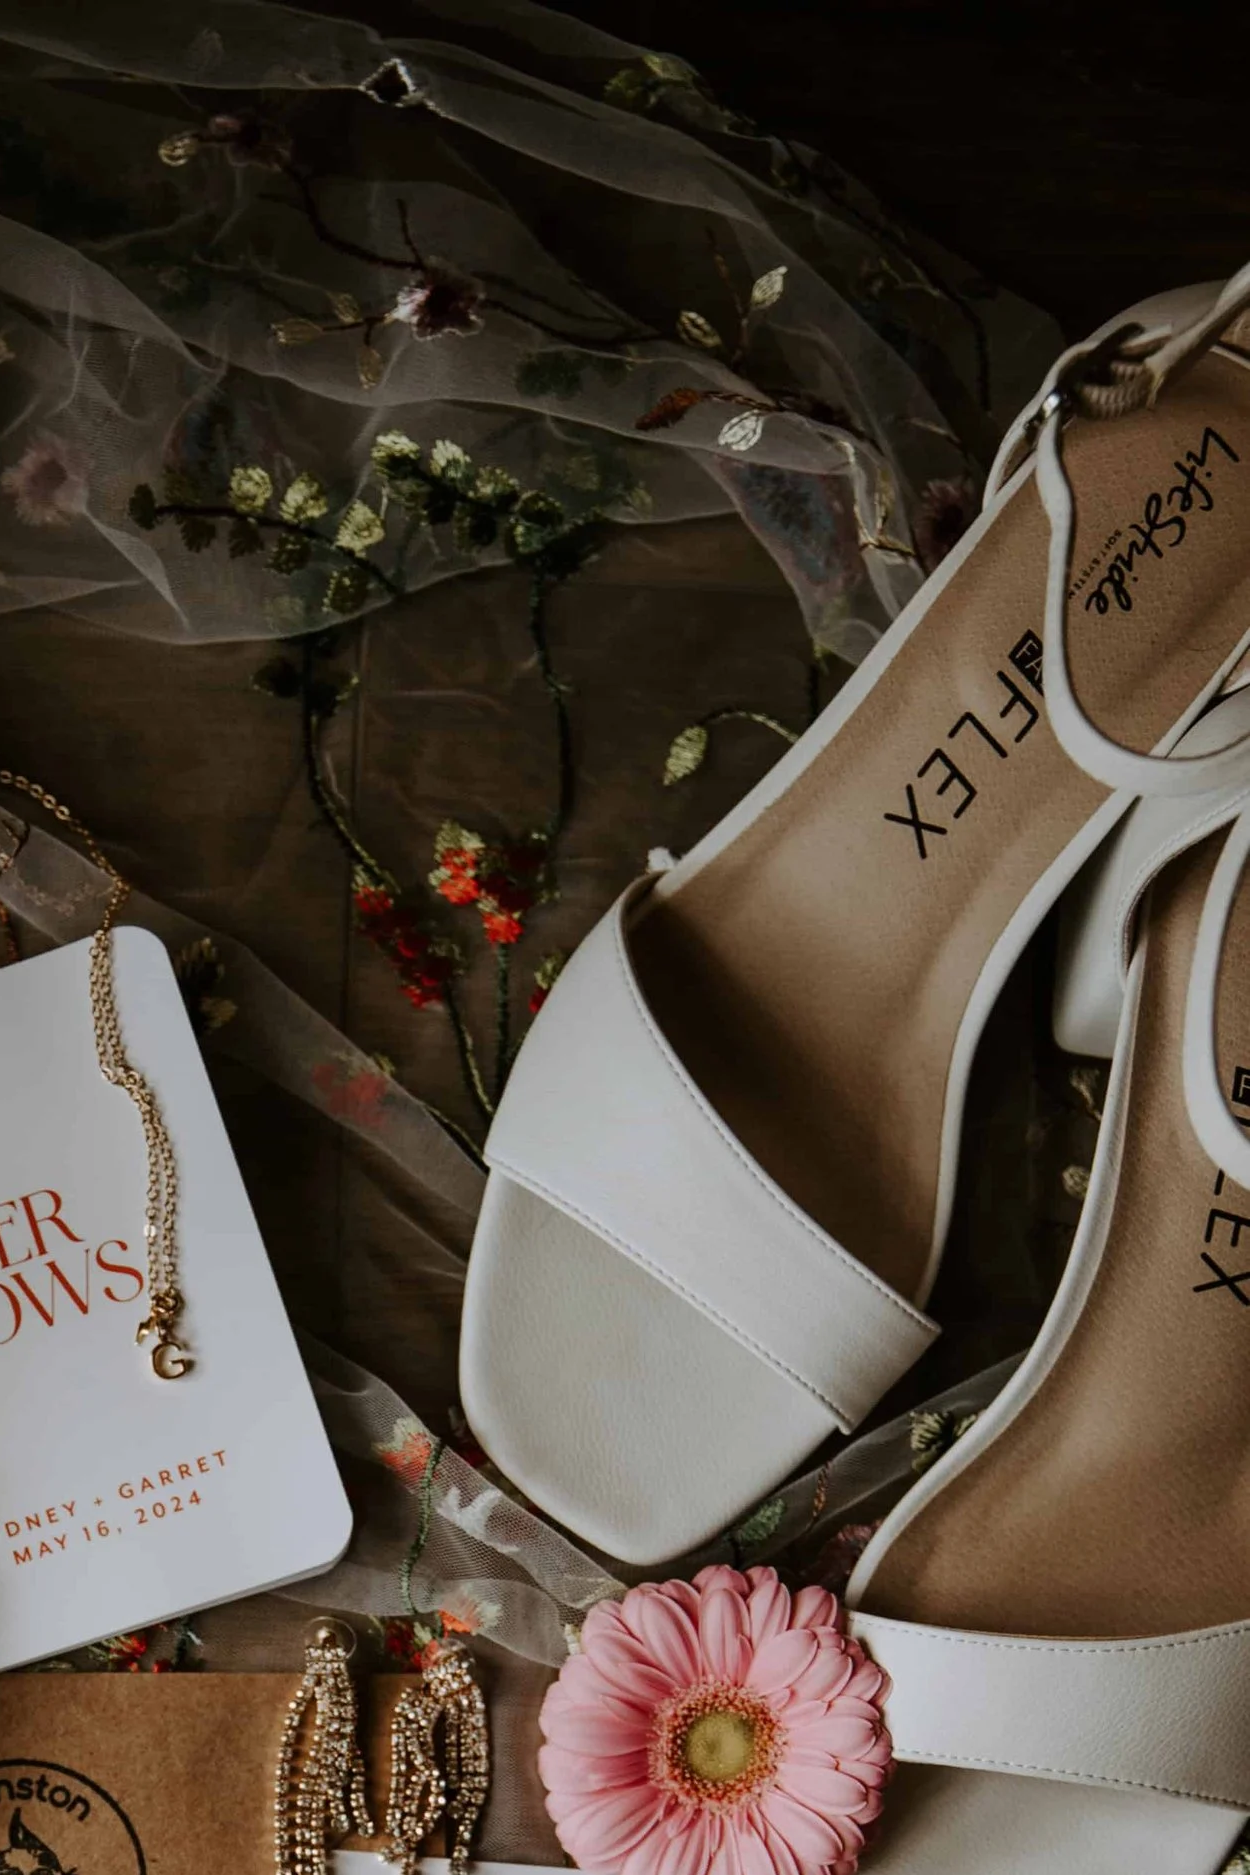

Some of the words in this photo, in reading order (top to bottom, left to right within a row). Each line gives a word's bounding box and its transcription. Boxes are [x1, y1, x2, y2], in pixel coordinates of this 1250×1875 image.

[1085, 426, 1241, 615] LifeStride
[1100, 529, 1122, 557] SOFT
[883, 669, 1040, 860] FLEX
[117, 1449, 229, 1500] GARRET
[12, 1533, 70, 1566] MAY
[83, 1521, 124, 1542] 16,
[134, 1489, 203, 1525] 2024
